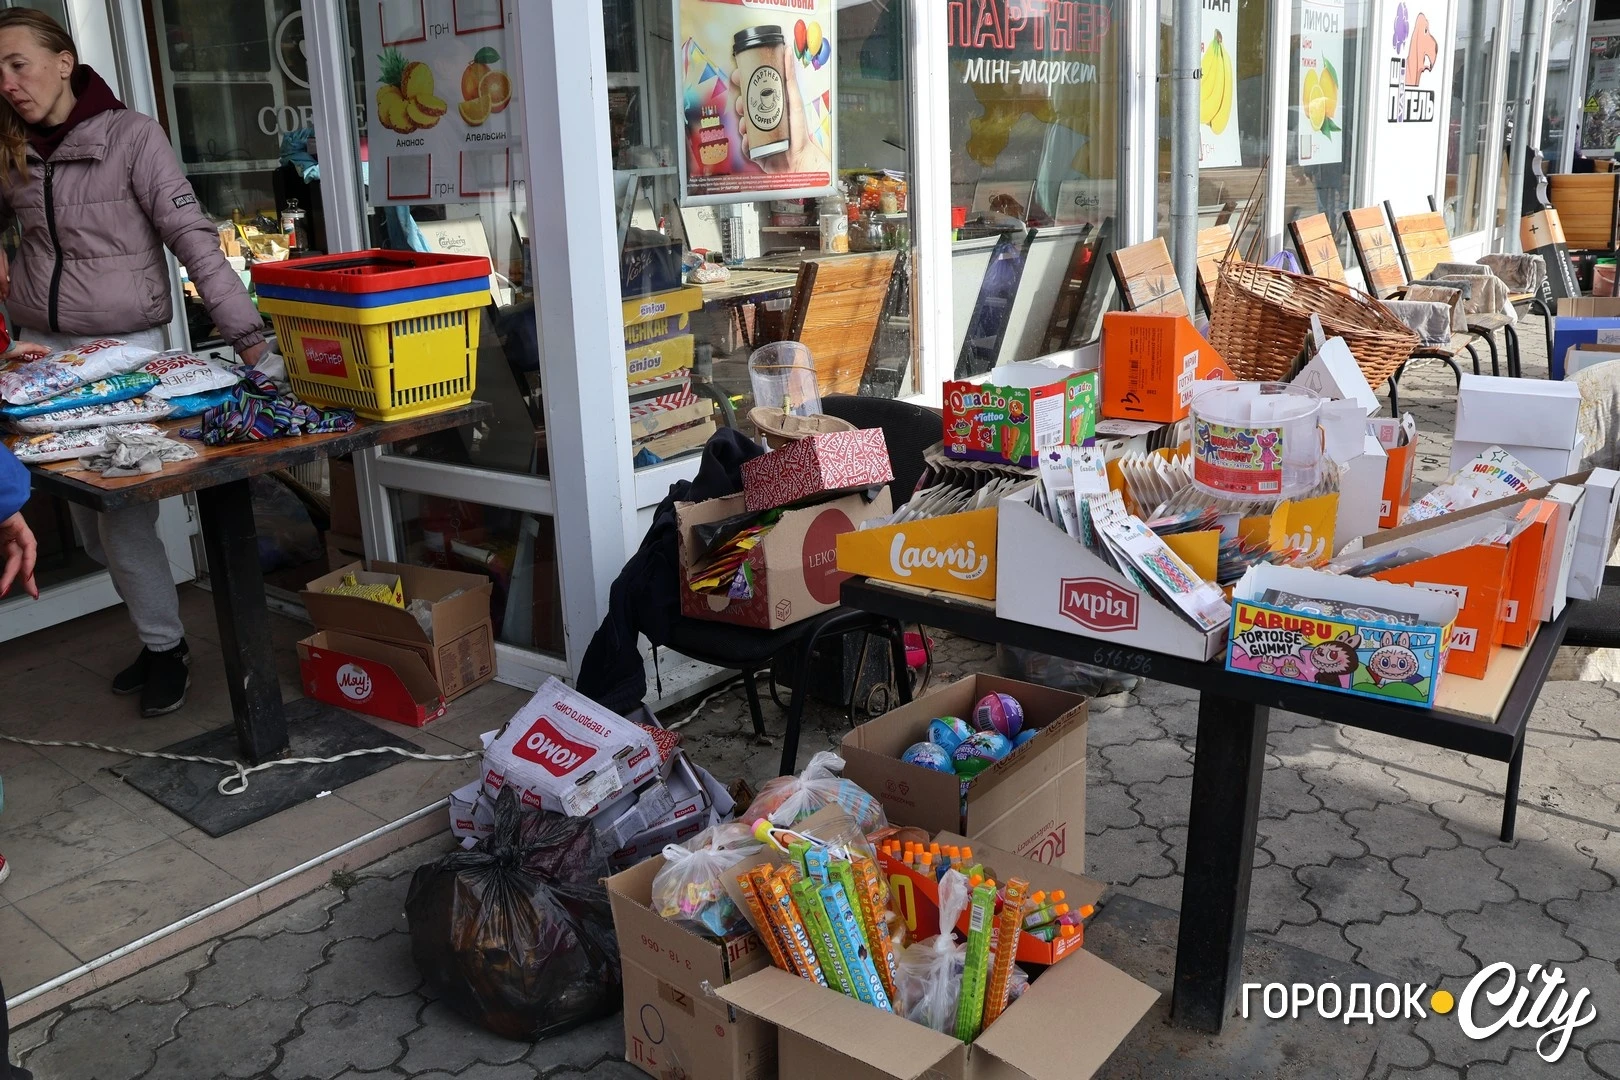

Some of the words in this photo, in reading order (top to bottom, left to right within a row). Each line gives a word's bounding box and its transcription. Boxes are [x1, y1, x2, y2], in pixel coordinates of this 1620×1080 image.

[948, 0, 1112, 52] ПАРТНЕР
[1303, 9, 1339, 34] ЛИМОН
[430, 23, 449, 39] грн
[753, 70, 778, 86] ПАРТНЕР
[396, 138, 424, 147] Ананас
[466, 131, 506, 142] Апельсин
[435, 183, 455, 198] грн
[640, 303, 666, 316] enjoy
[629, 356, 661, 373] enjoy
[1068, 382, 1092, 400] Quadro
[950, 391, 1006, 414] Quadro
[1473, 463, 1507, 479] HAPPY
[890, 532, 976, 577] Lacmi
[1239, 606, 1332, 640] LABUBU
[1239, 630, 1302, 646] TORTOISE
[1249, 643, 1293, 656] GUMMY
[338, 673, 370, 695] Мяу!
[552, 700, 571, 715] СИРУ
[572, 708, 605, 735] ТВЕРДОГО
[641, 934, 659, 953] 056
[793, 923, 816, 965] SUPER
